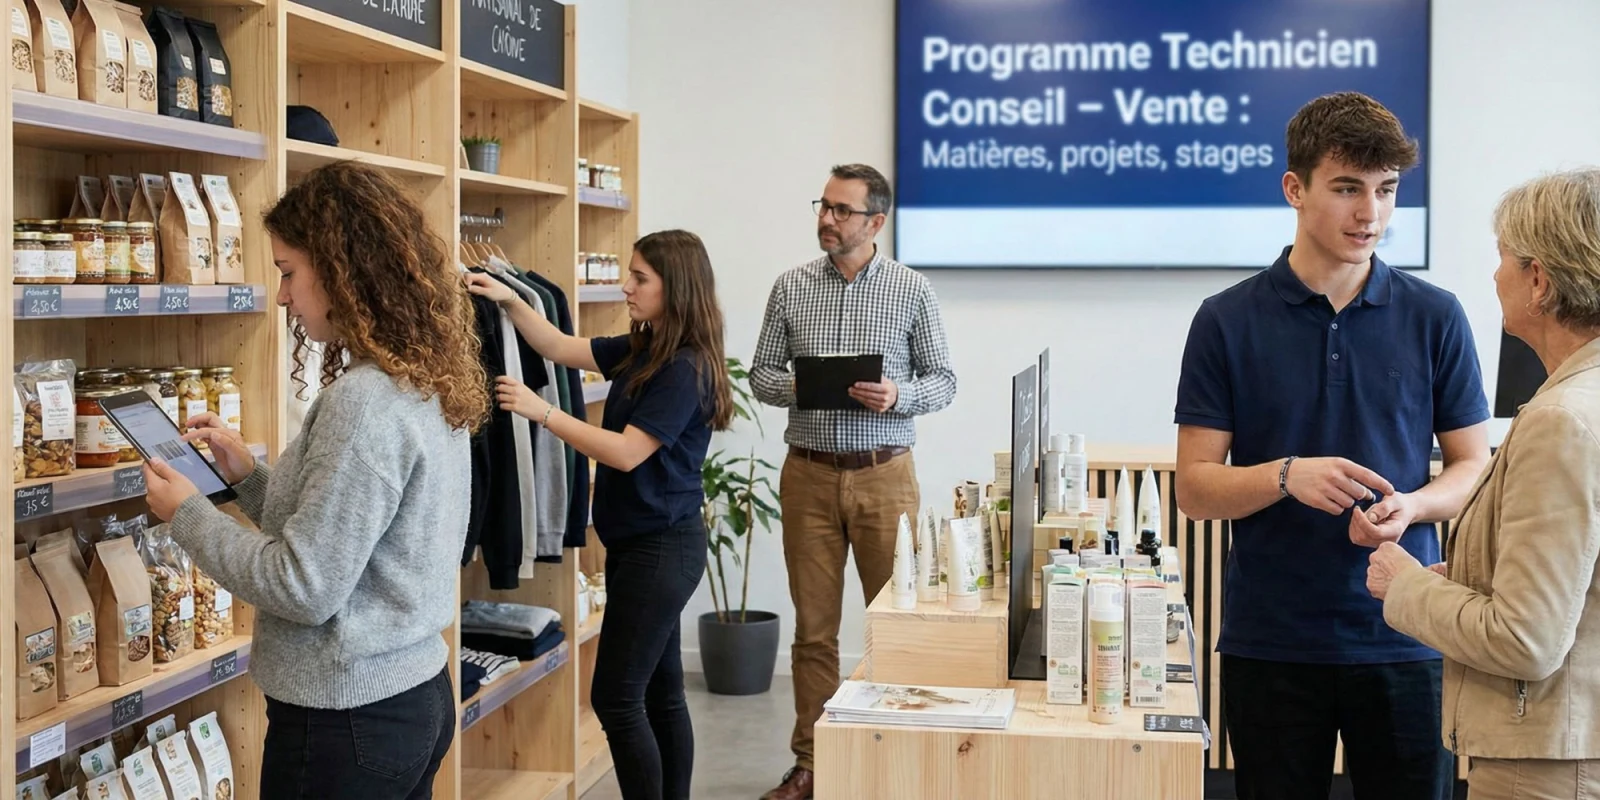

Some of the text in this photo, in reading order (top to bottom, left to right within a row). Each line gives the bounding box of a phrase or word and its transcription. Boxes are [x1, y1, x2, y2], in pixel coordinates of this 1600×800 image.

[923, 31, 1378, 81] Programme Technicien
[923, 87, 1066, 126] Conseil
[1114, 89, 1228, 125] Vente
[922, 139, 1273, 174] Matières, projets, stages
